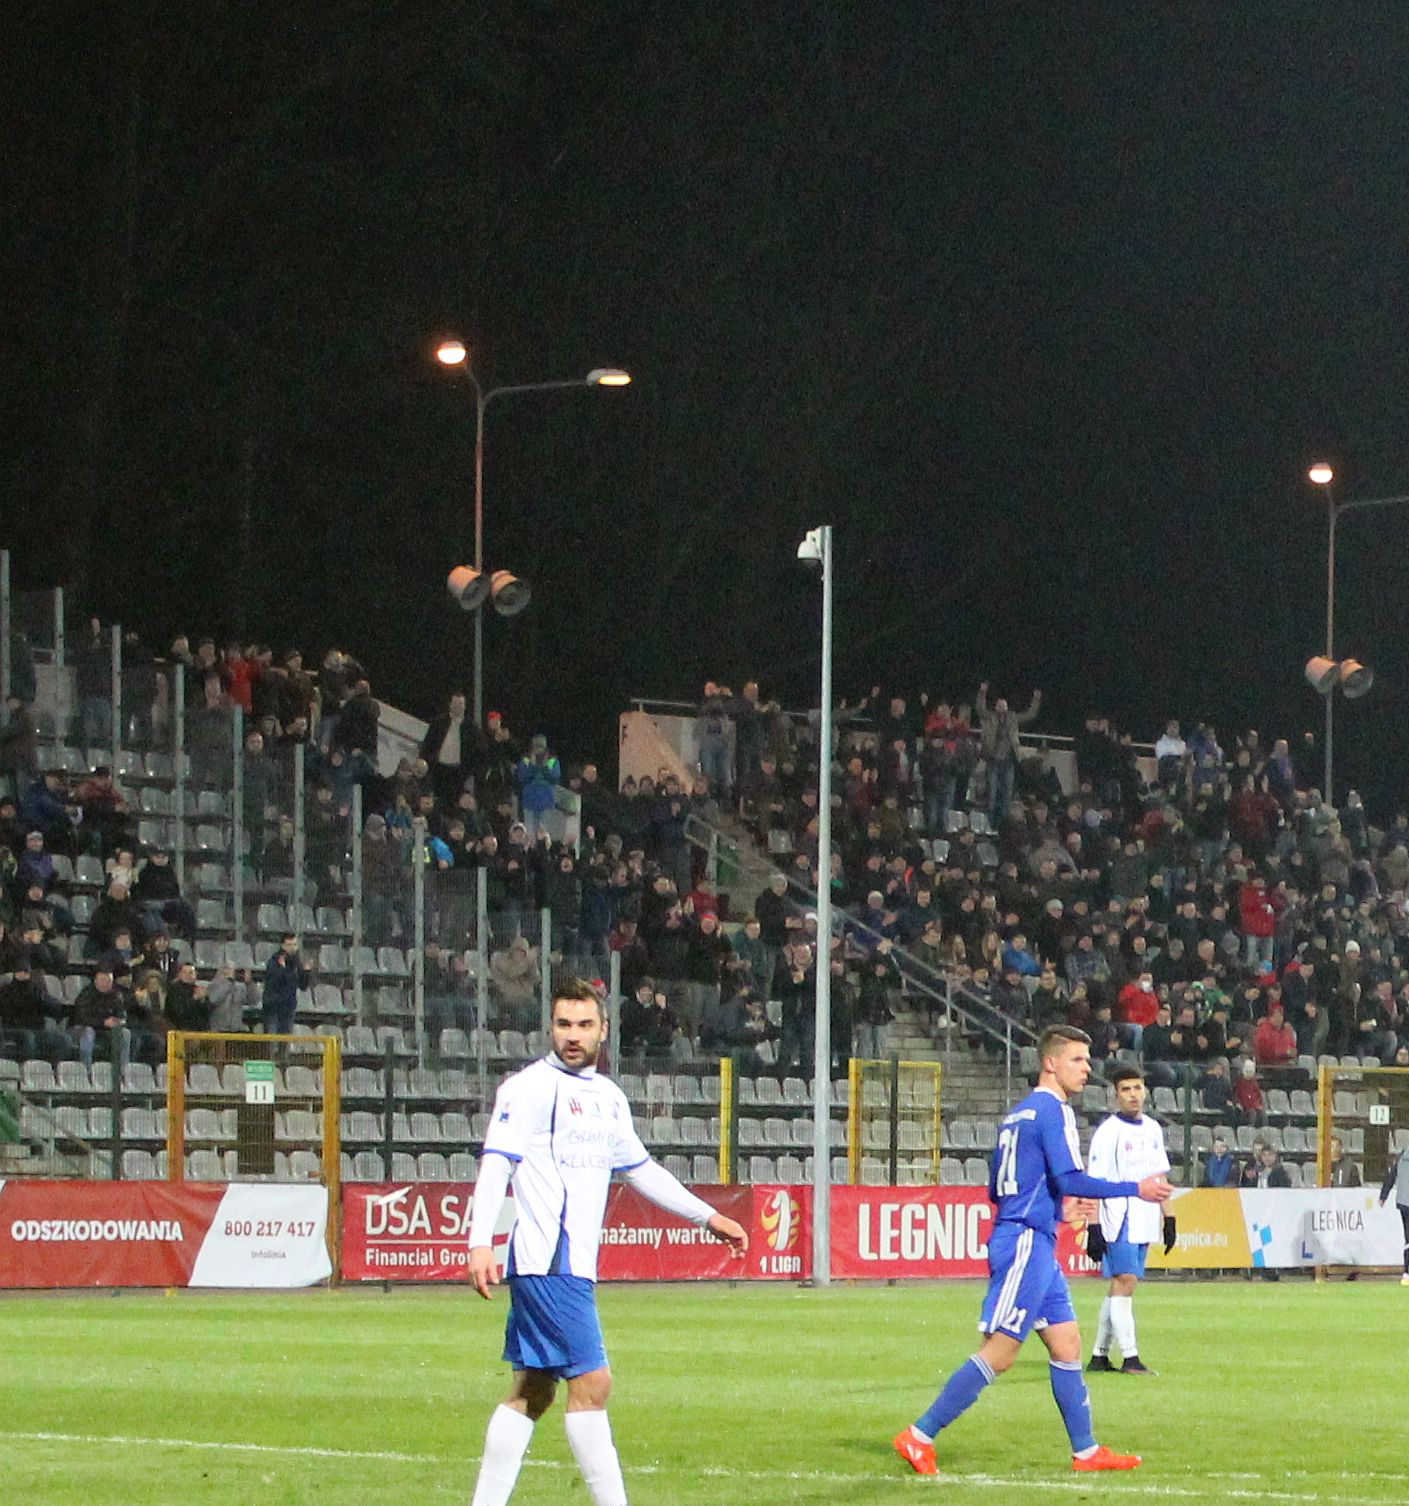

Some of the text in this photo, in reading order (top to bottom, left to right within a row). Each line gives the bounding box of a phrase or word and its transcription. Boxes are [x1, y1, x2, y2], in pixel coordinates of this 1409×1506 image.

[254, 1085, 267, 1101] 11
[365, 1195, 432, 1235] DSA
[1311, 1210, 1364, 1231] LEGNICA
[11, 1220, 183, 1241] ODSZKODOWANIA
[225, 1221, 315, 1236] 800 217 417
[600, 1223, 663, 1249] nażamy
[858, 1203, 991, 1260] LEGNIC
[1175, 1227, 1229, 1251] egnica.eu
[365, 1248, 434, 1266] Financial
[760, 1256, 801, 1273] 1 LIGA
